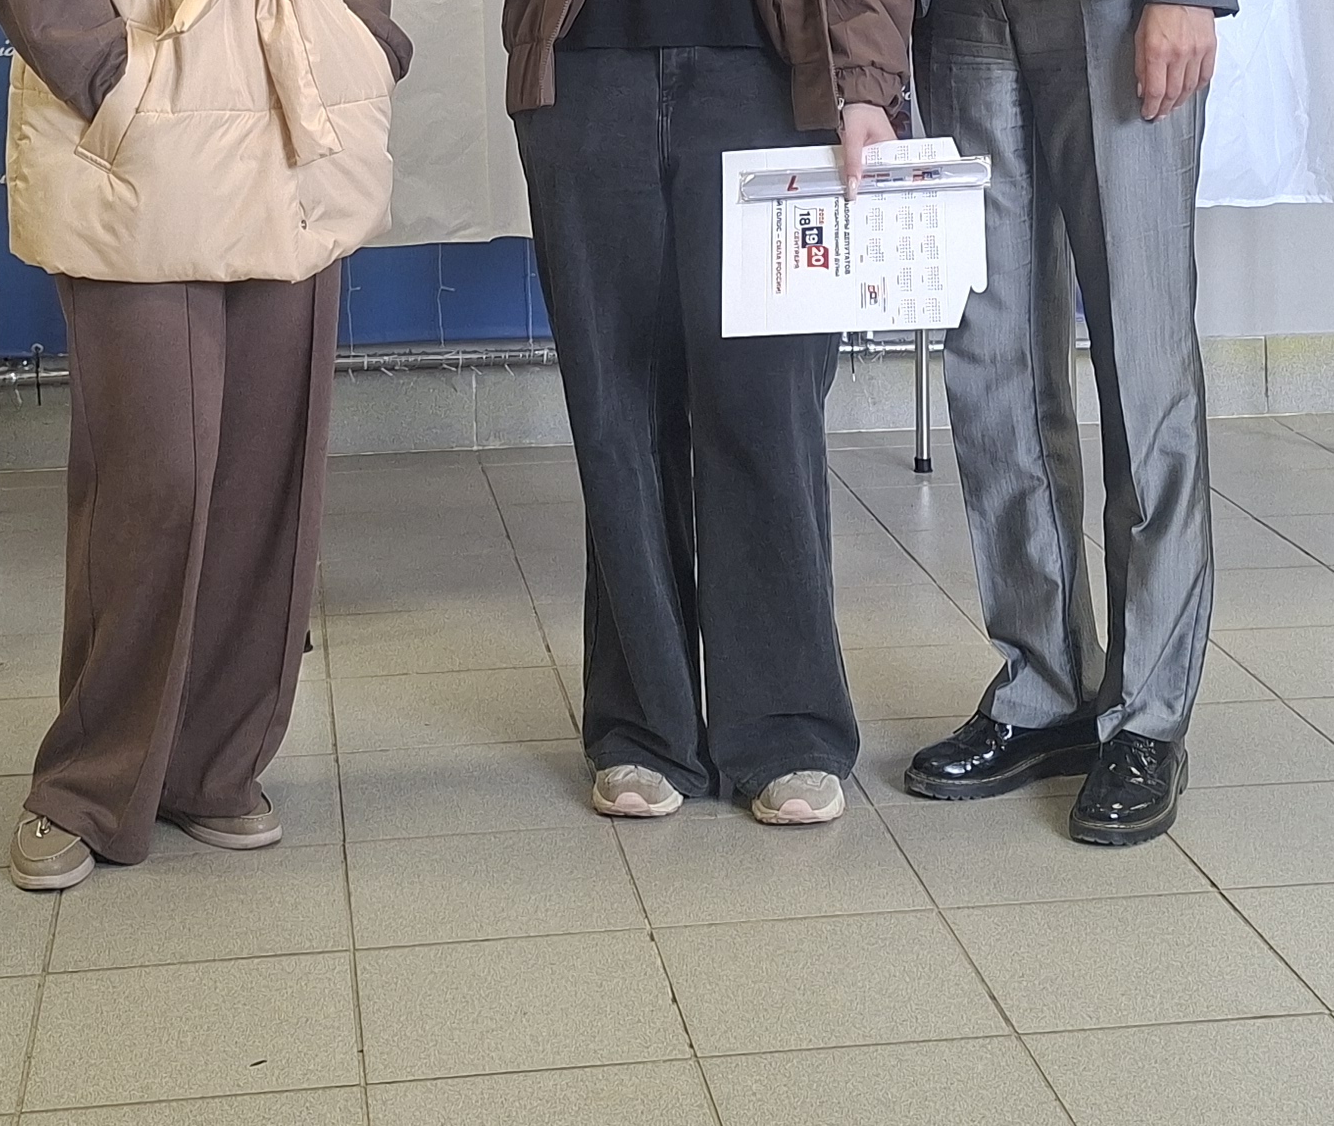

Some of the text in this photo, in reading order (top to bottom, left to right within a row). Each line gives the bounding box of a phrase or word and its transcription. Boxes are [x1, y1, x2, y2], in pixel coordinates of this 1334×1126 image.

[798, 211, 824, 266] 18 19 20
